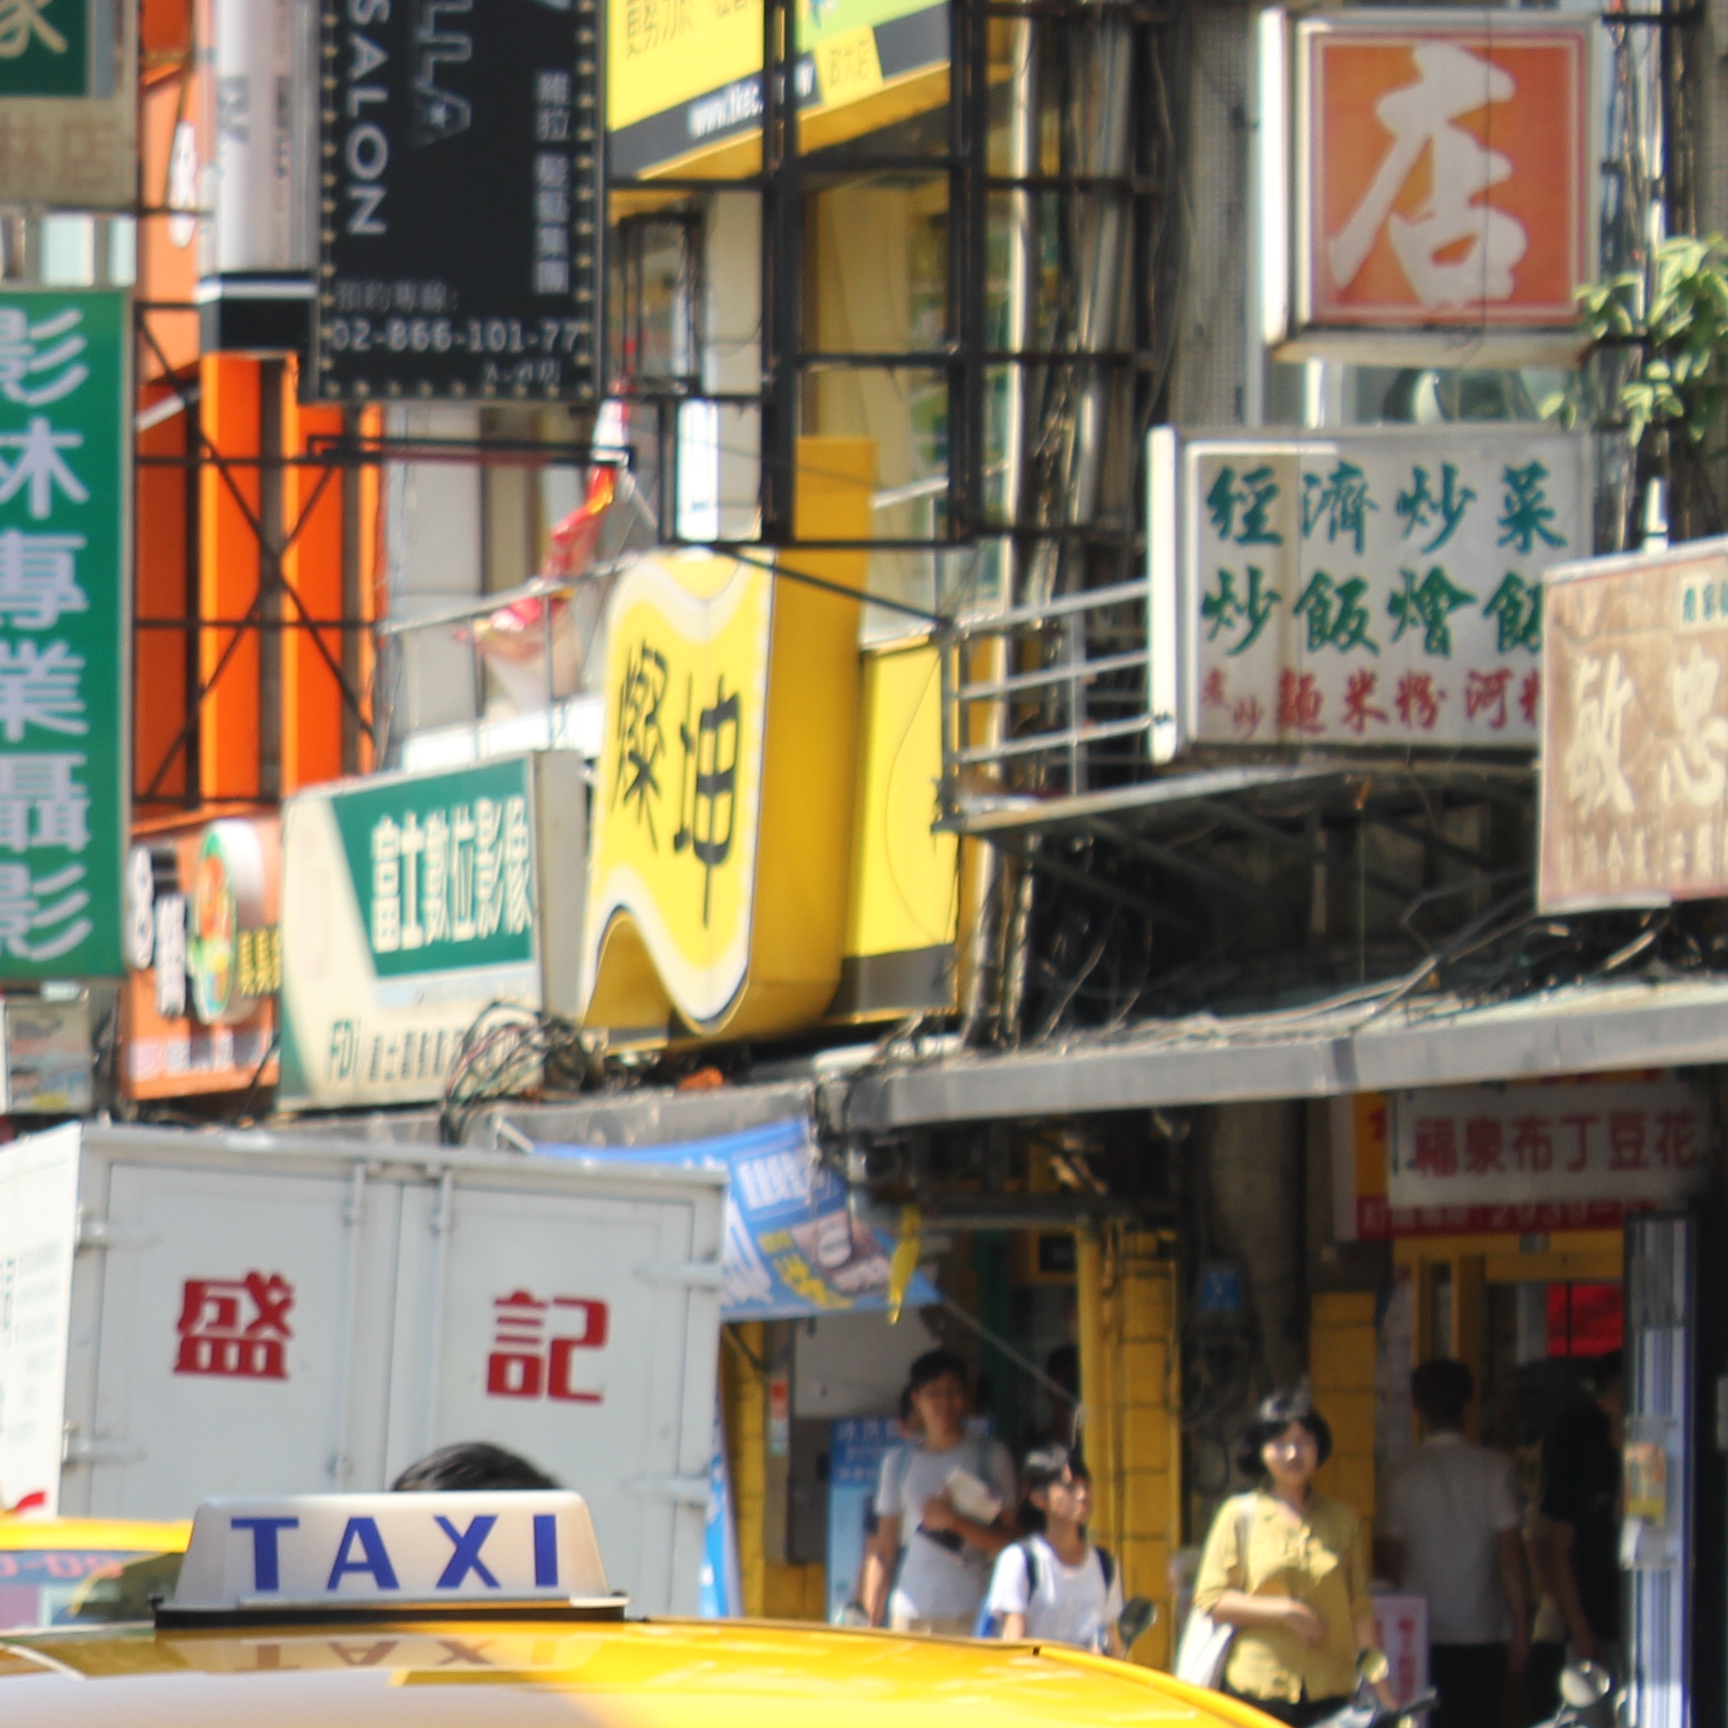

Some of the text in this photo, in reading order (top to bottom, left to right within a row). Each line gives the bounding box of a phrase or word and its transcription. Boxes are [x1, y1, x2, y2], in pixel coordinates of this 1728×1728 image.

[1329, 42, 1528, 309] 店
[330, 317, 581, 352] 02-866-101-77
[1205, 460, 1568, 556] 經濟炒菜
[607, 642, 743, 930] 燦坤
[172, 1269, 610, 1405] 盛記
[230, 1514, 559, 1593] TAXI
